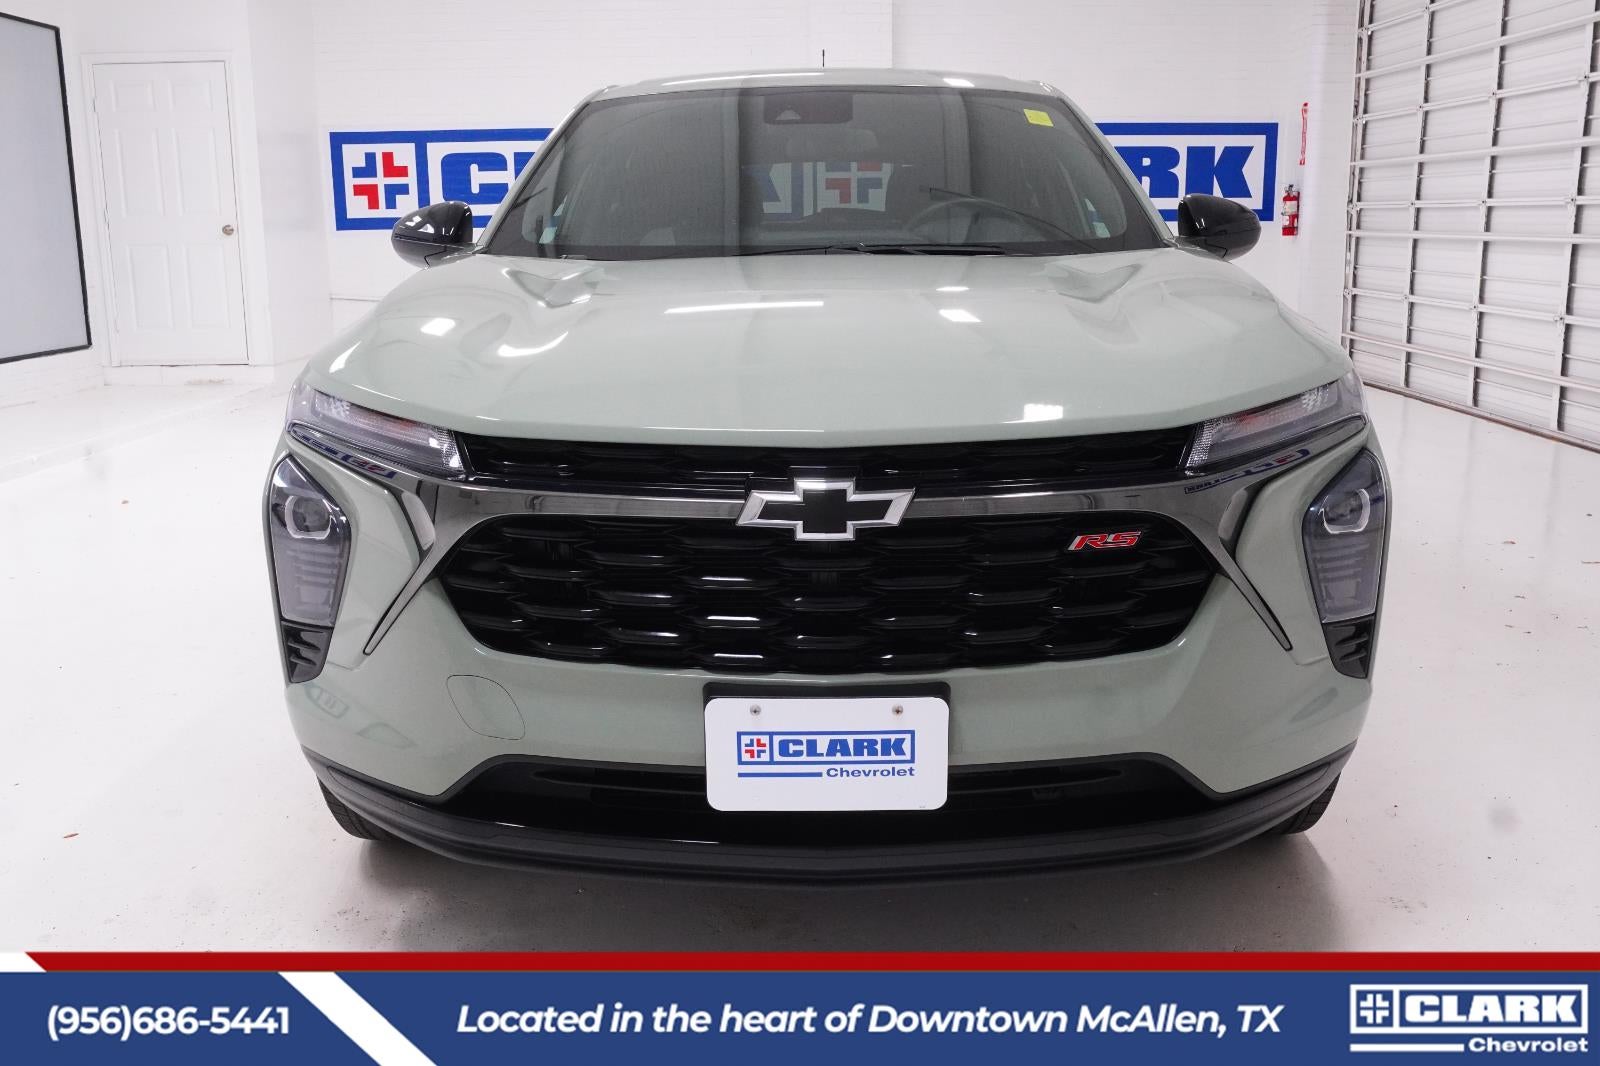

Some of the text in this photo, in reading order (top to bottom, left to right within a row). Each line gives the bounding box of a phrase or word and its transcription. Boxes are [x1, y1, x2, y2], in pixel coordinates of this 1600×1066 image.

[441, 151, 536, 206] C
[1067, 531, 1141, 551] RS
[777, 737, 907, 758] CLARK
[825, 766, 916, 778] Chevrolet
